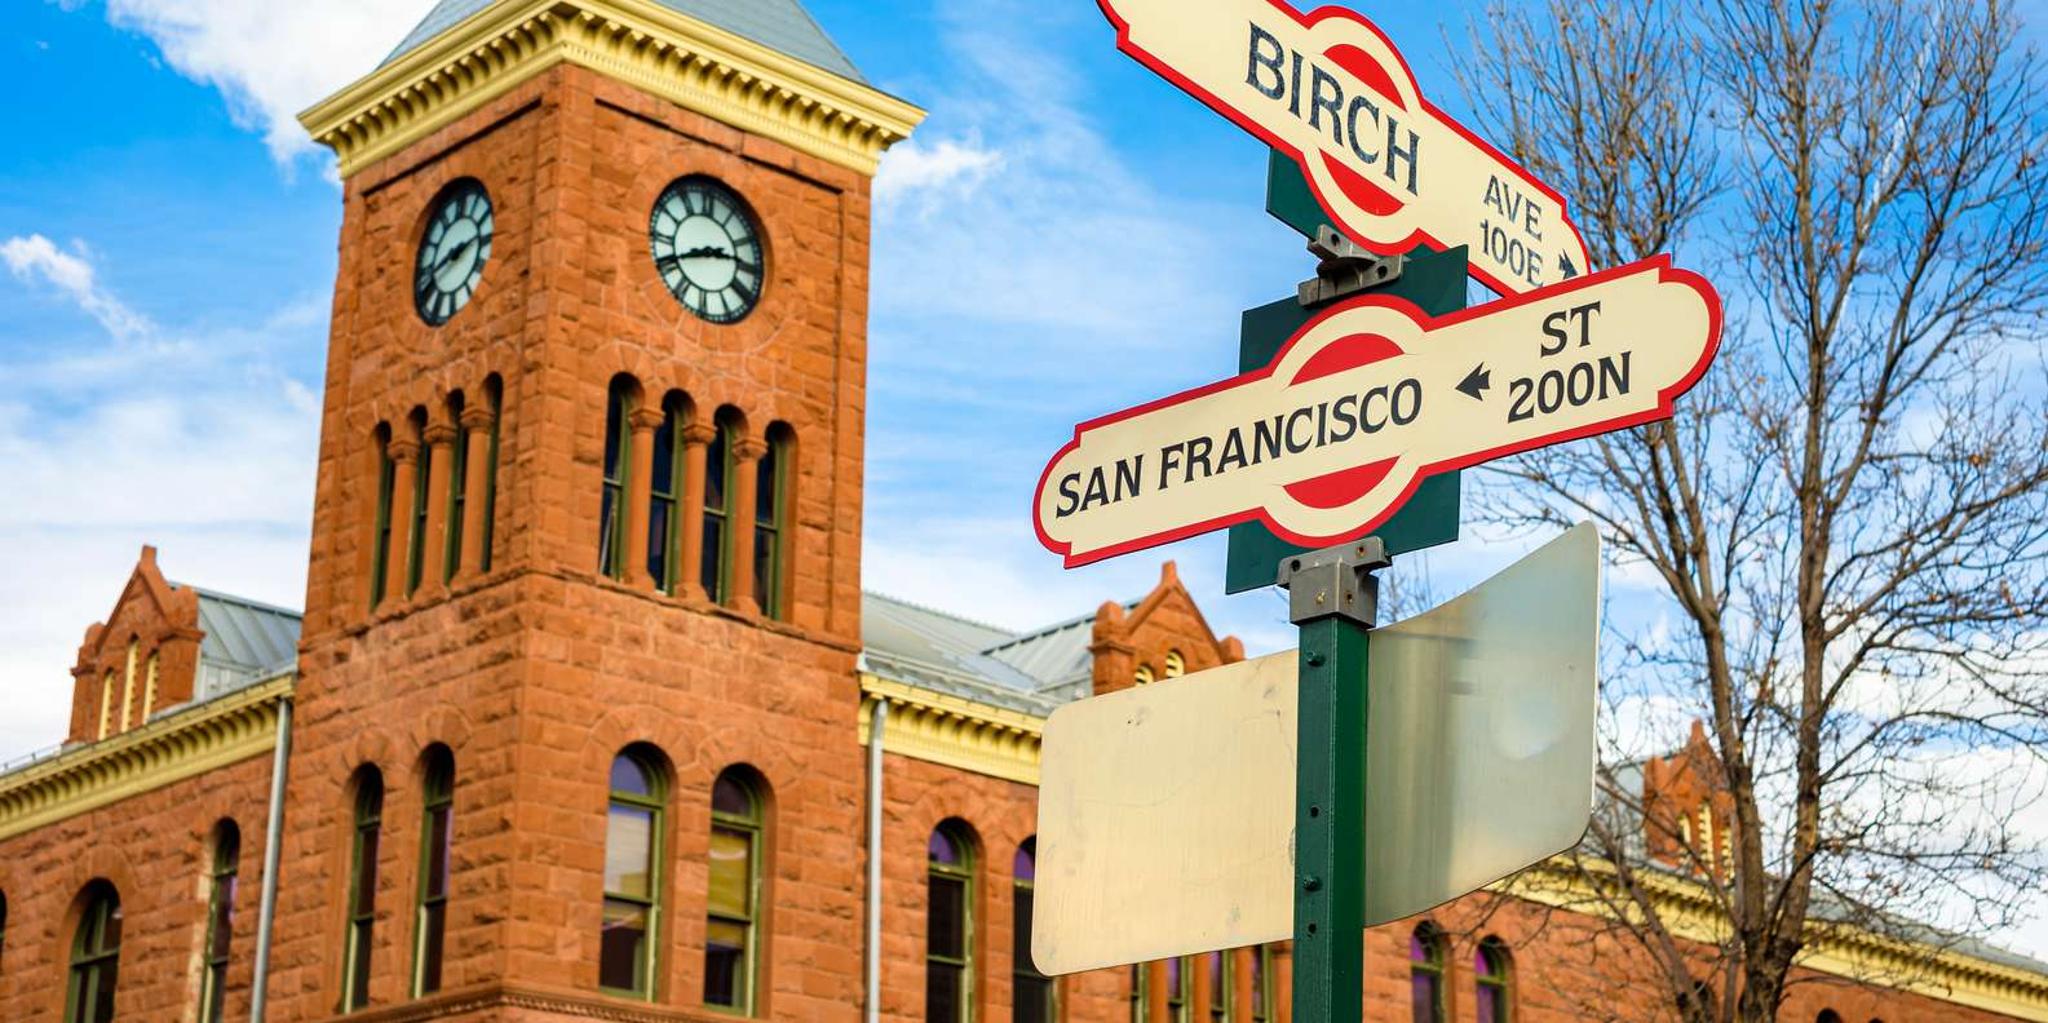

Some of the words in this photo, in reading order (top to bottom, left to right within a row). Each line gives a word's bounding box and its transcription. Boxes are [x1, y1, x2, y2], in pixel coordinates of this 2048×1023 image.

[1245, 20, 1420, 196] BIRCH
[1484, 175, 1542, 242] AVE
[1480, 218, 1543, 287] 100E
[1541, 301, 1601, 358] ST
[1508, 351, 1632, 424] 200N
[1056, 454, 1144, 518] SAN
[1158, 378, 1422, 490] FRANCISCO
